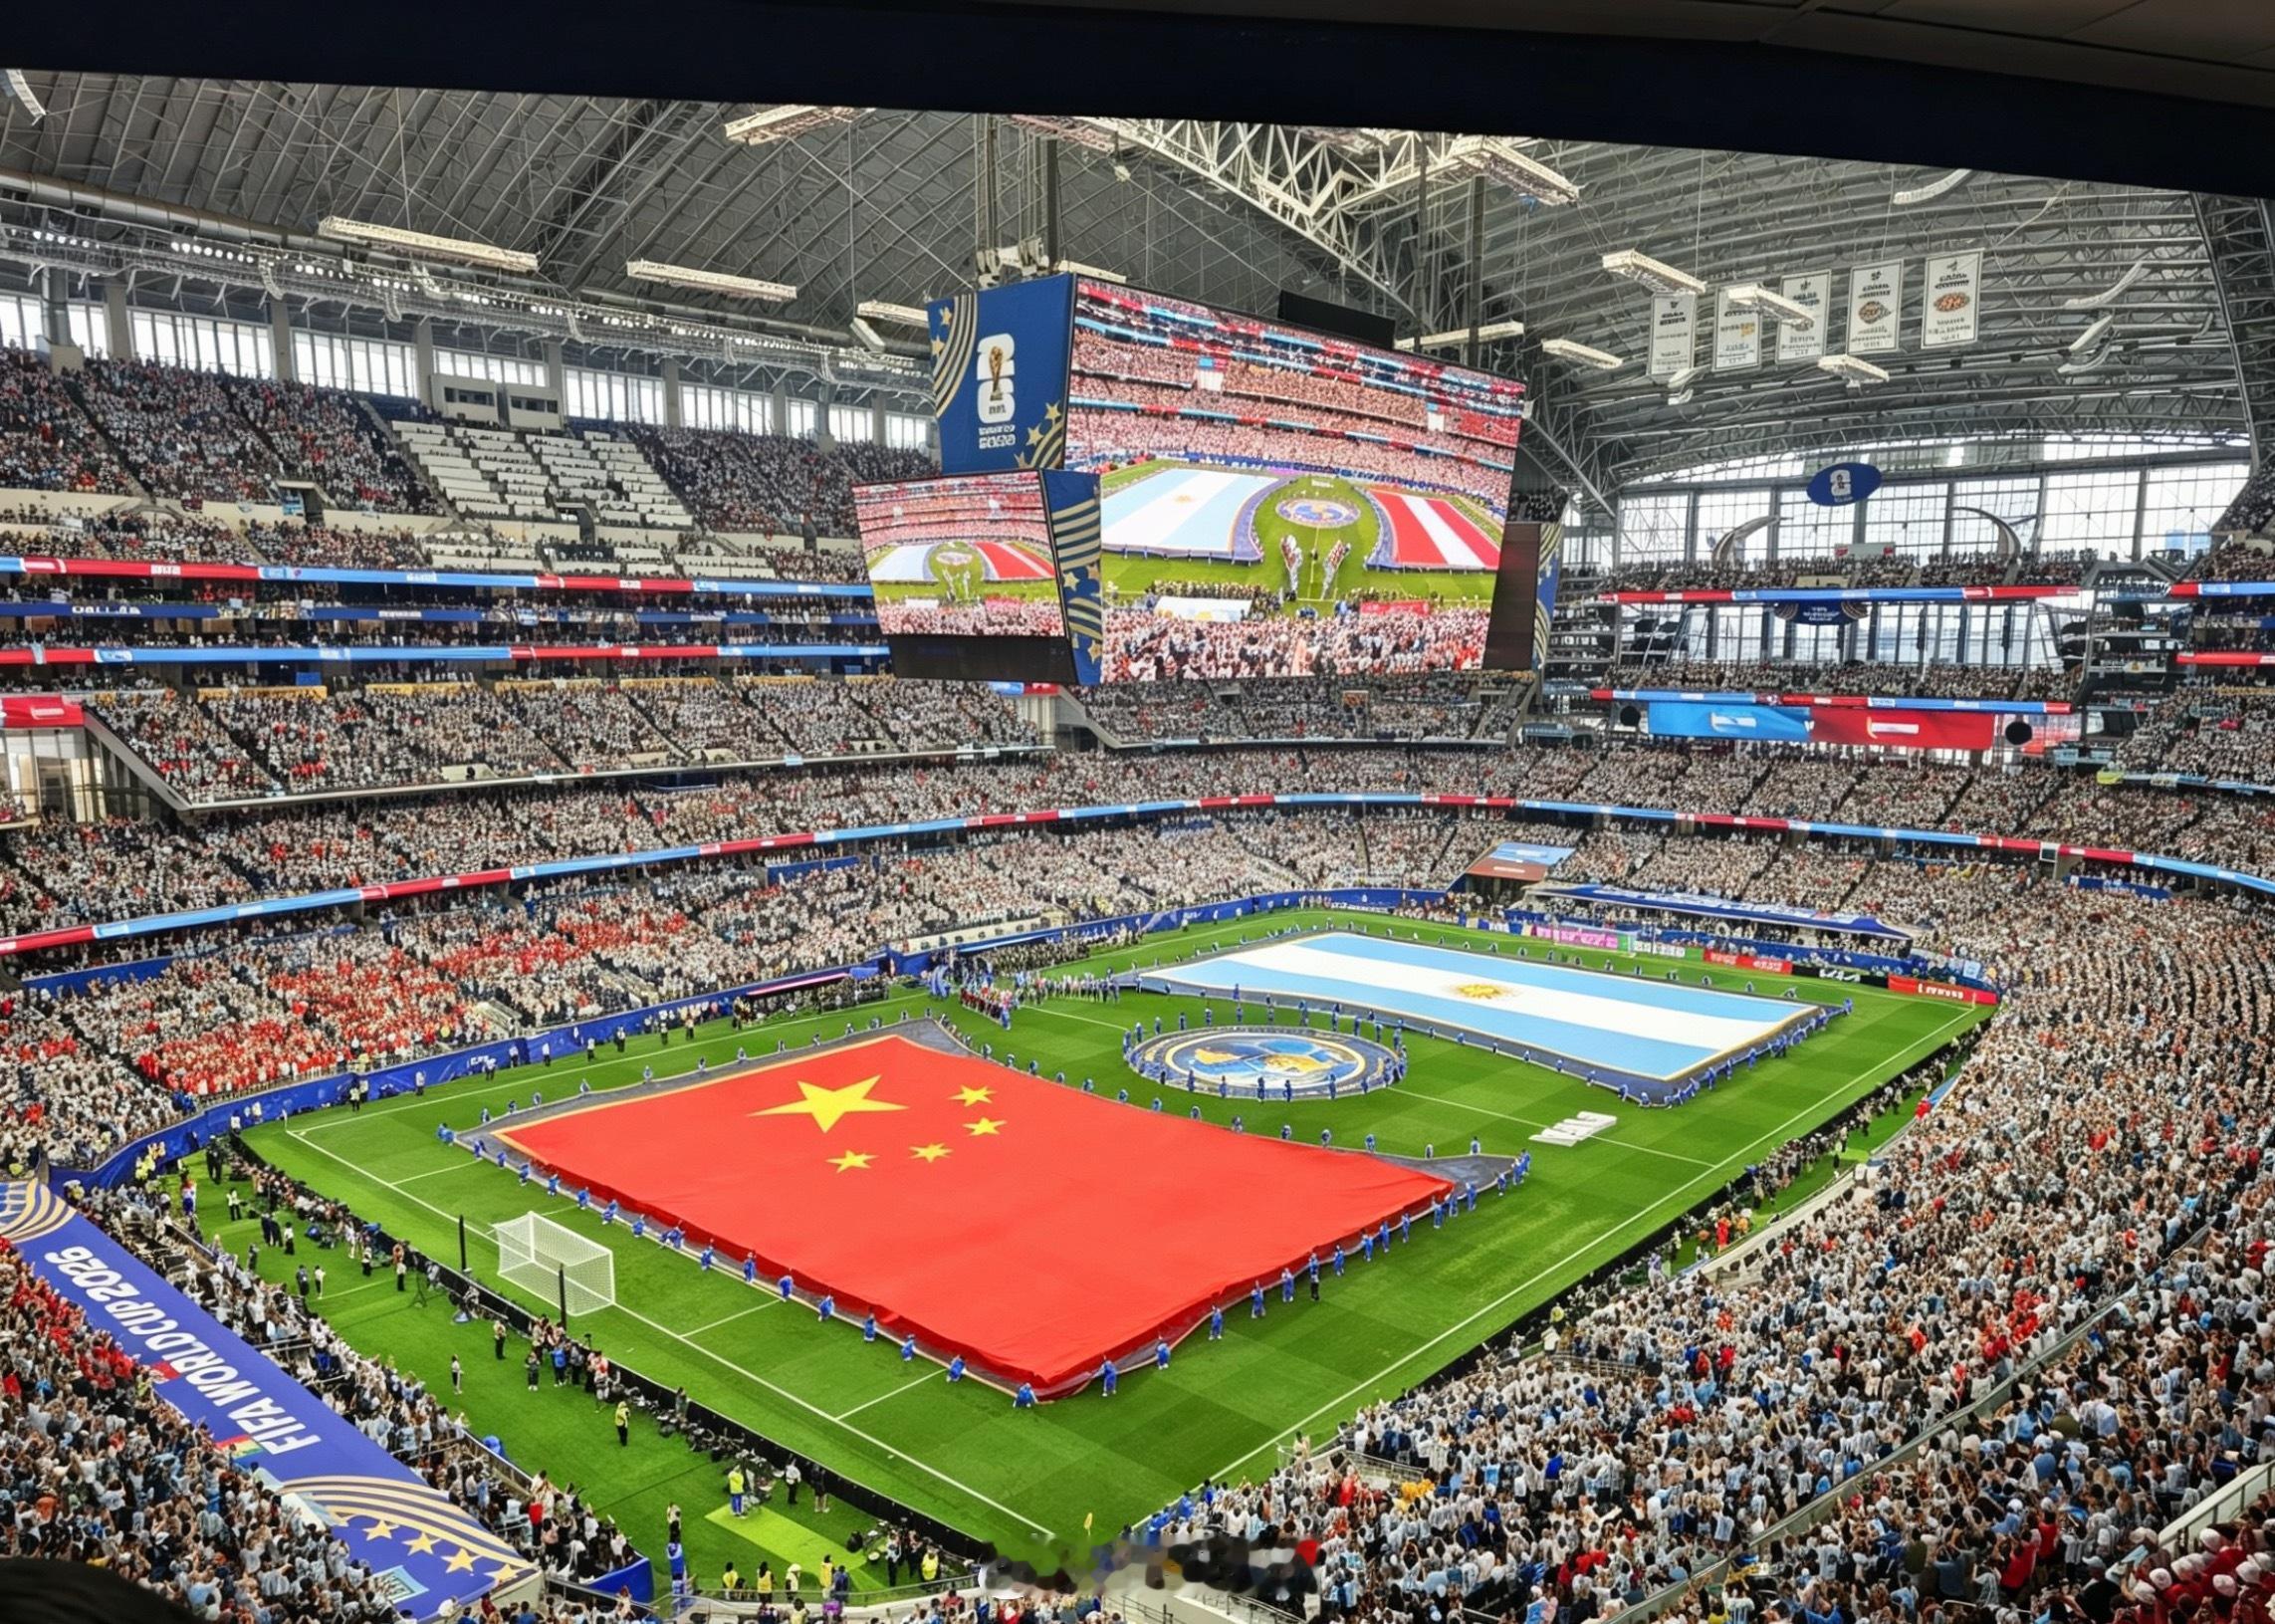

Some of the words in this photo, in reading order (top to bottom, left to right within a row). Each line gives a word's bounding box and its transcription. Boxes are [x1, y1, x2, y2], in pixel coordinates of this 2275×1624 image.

[45, 1247, 140, 1302] 2026
[105, 1300, 178, 1335] CUP
[145, 1333, 260, 1407] WORLD
[228, 1398, 321, 1455] FIFA
